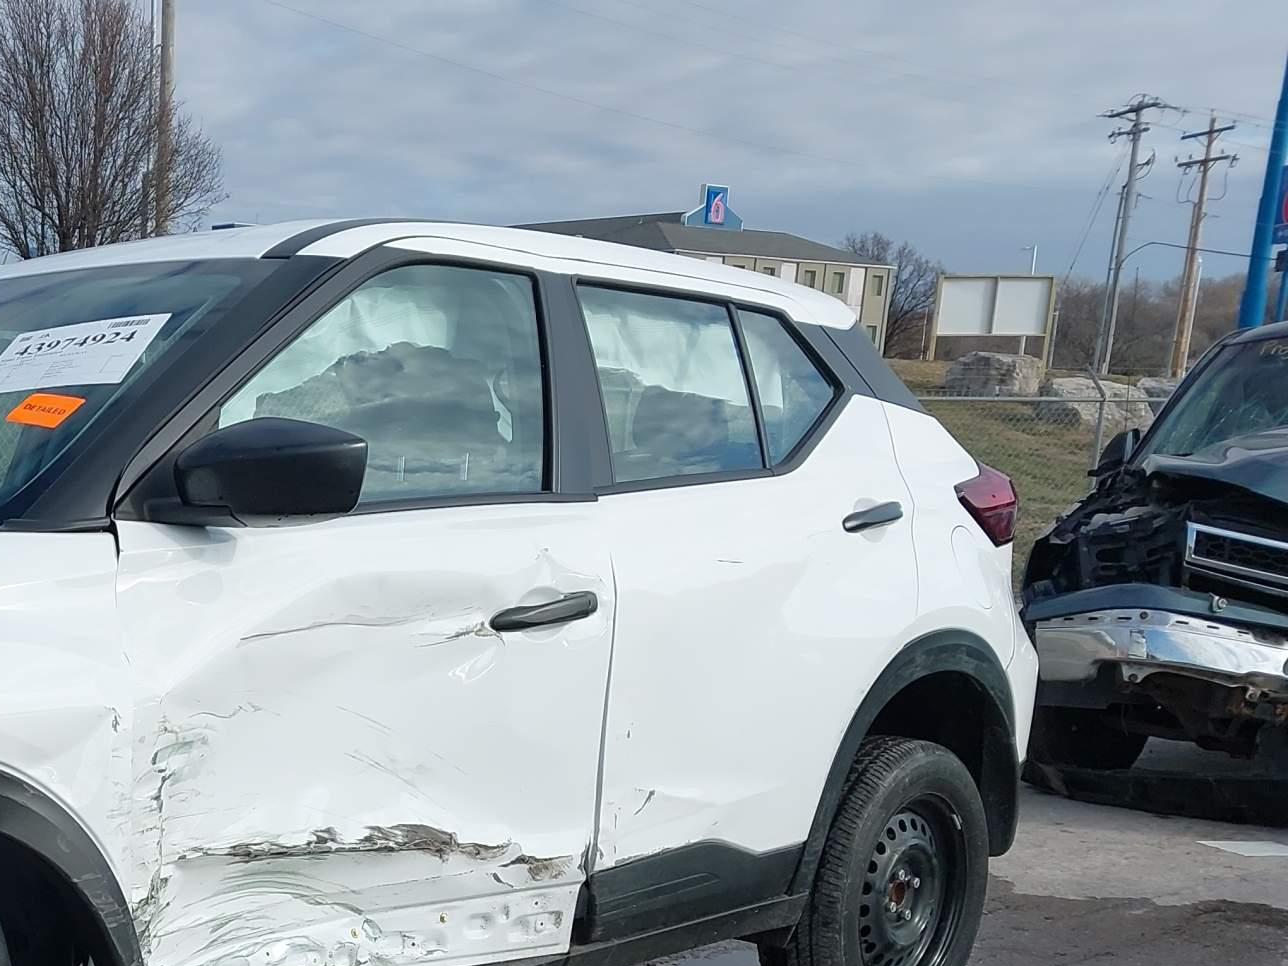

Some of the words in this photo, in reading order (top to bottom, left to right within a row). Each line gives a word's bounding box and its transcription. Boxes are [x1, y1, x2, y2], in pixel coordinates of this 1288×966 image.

[711, 193, 725, 224] 6
[15, 329, 138, 357] 43974924
[23, 403, 66, 416] DETAILED
